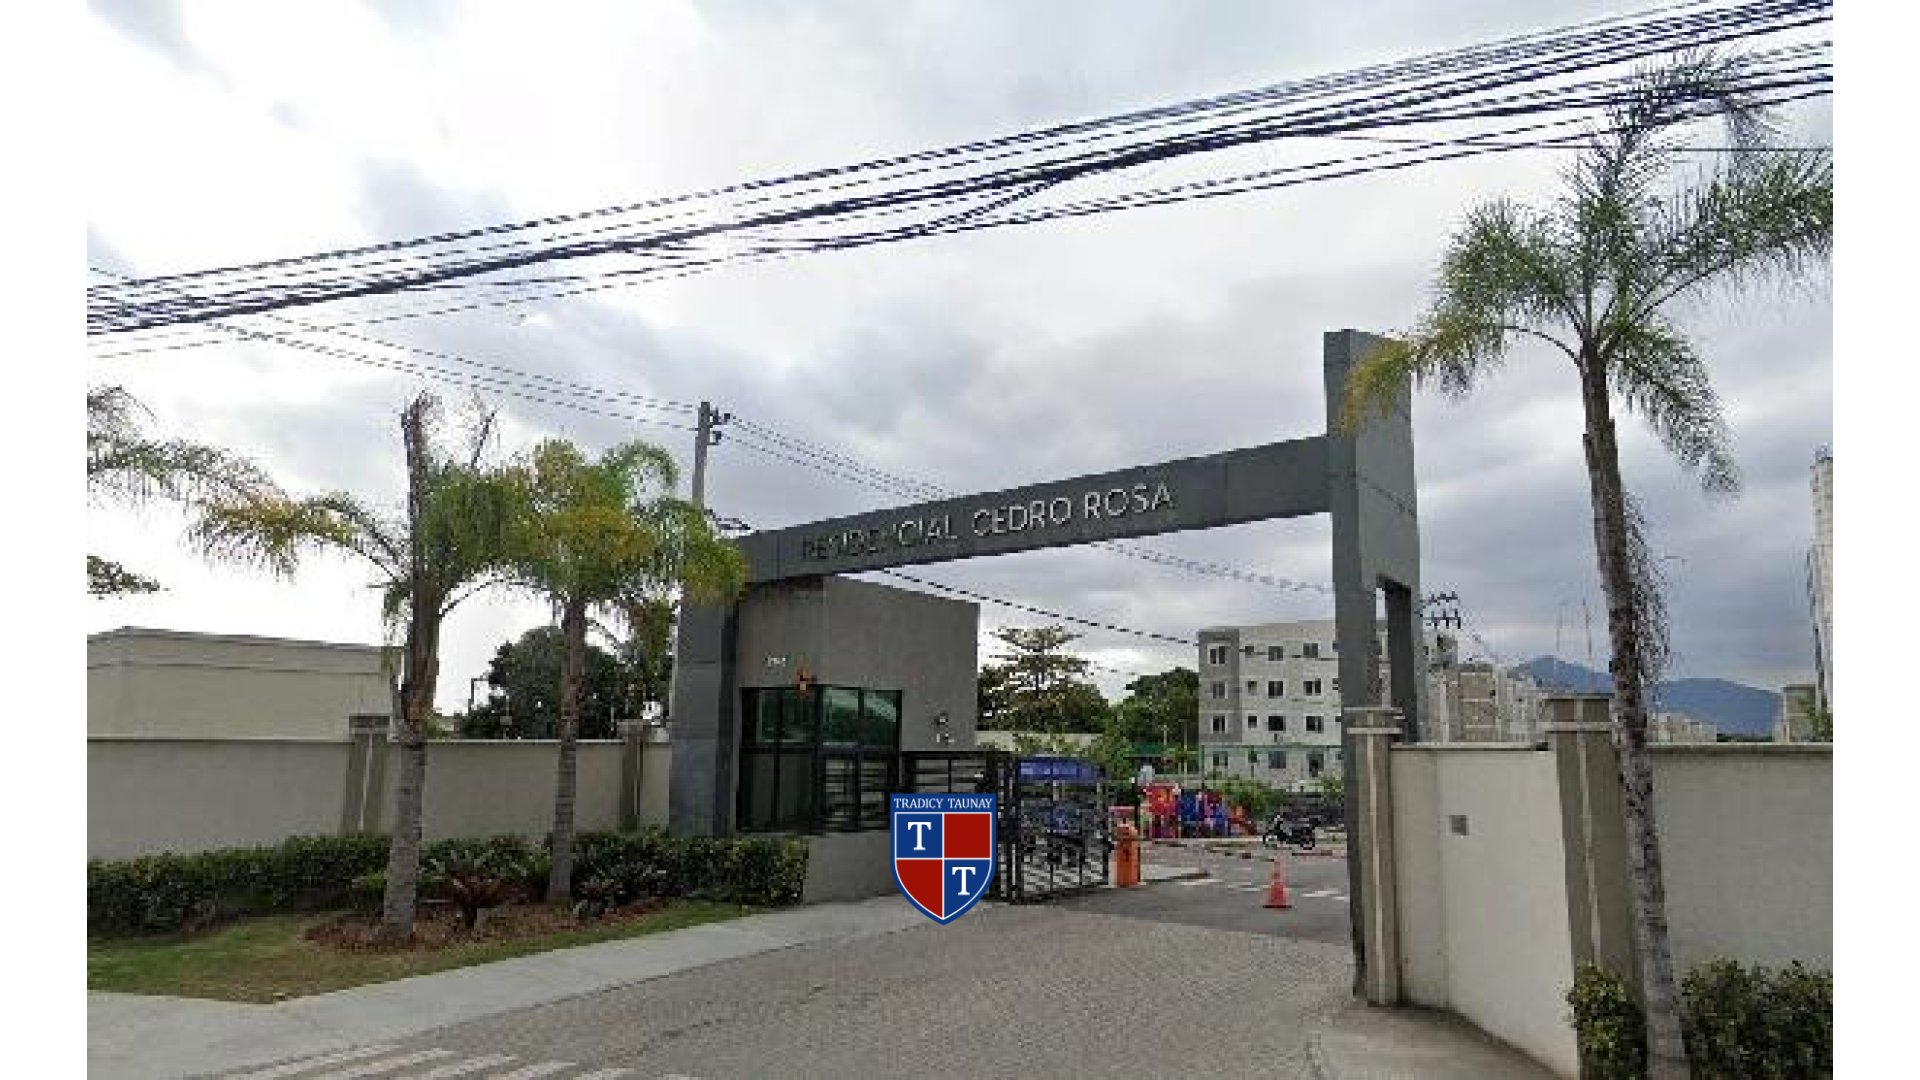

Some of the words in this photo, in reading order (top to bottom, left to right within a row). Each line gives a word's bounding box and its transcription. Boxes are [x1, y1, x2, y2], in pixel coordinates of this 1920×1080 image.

[801, 514, 958, 560] REIDECIAL
[971, 497, 1072, 537] CEDRO
[1083, 482, 1173, 519] ROSA
